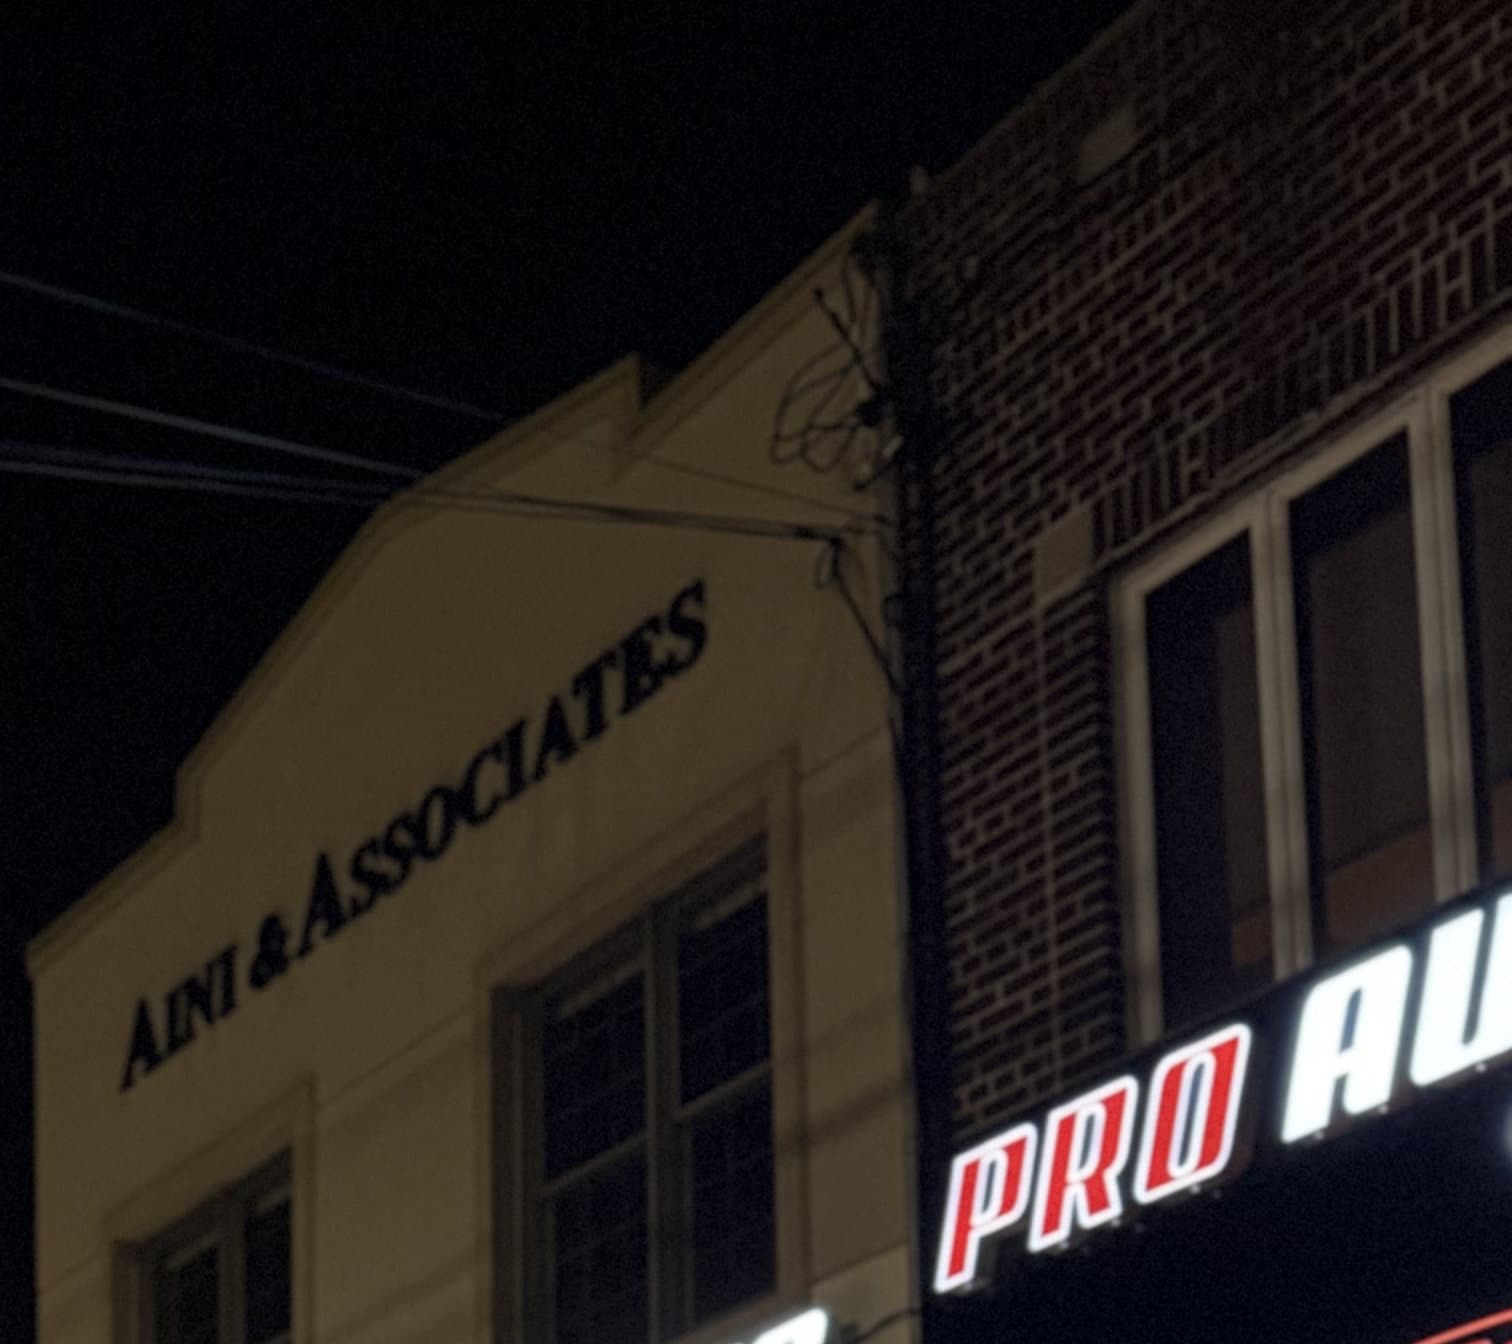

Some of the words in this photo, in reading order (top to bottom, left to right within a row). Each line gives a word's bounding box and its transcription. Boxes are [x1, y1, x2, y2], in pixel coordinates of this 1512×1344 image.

[118, 939, 240, 1094] AINI
[247, 913, 291, 990] &
[295, 580, 707, 961] ASSOCIATES
[935, 1023, 1251, 1293] PRO
